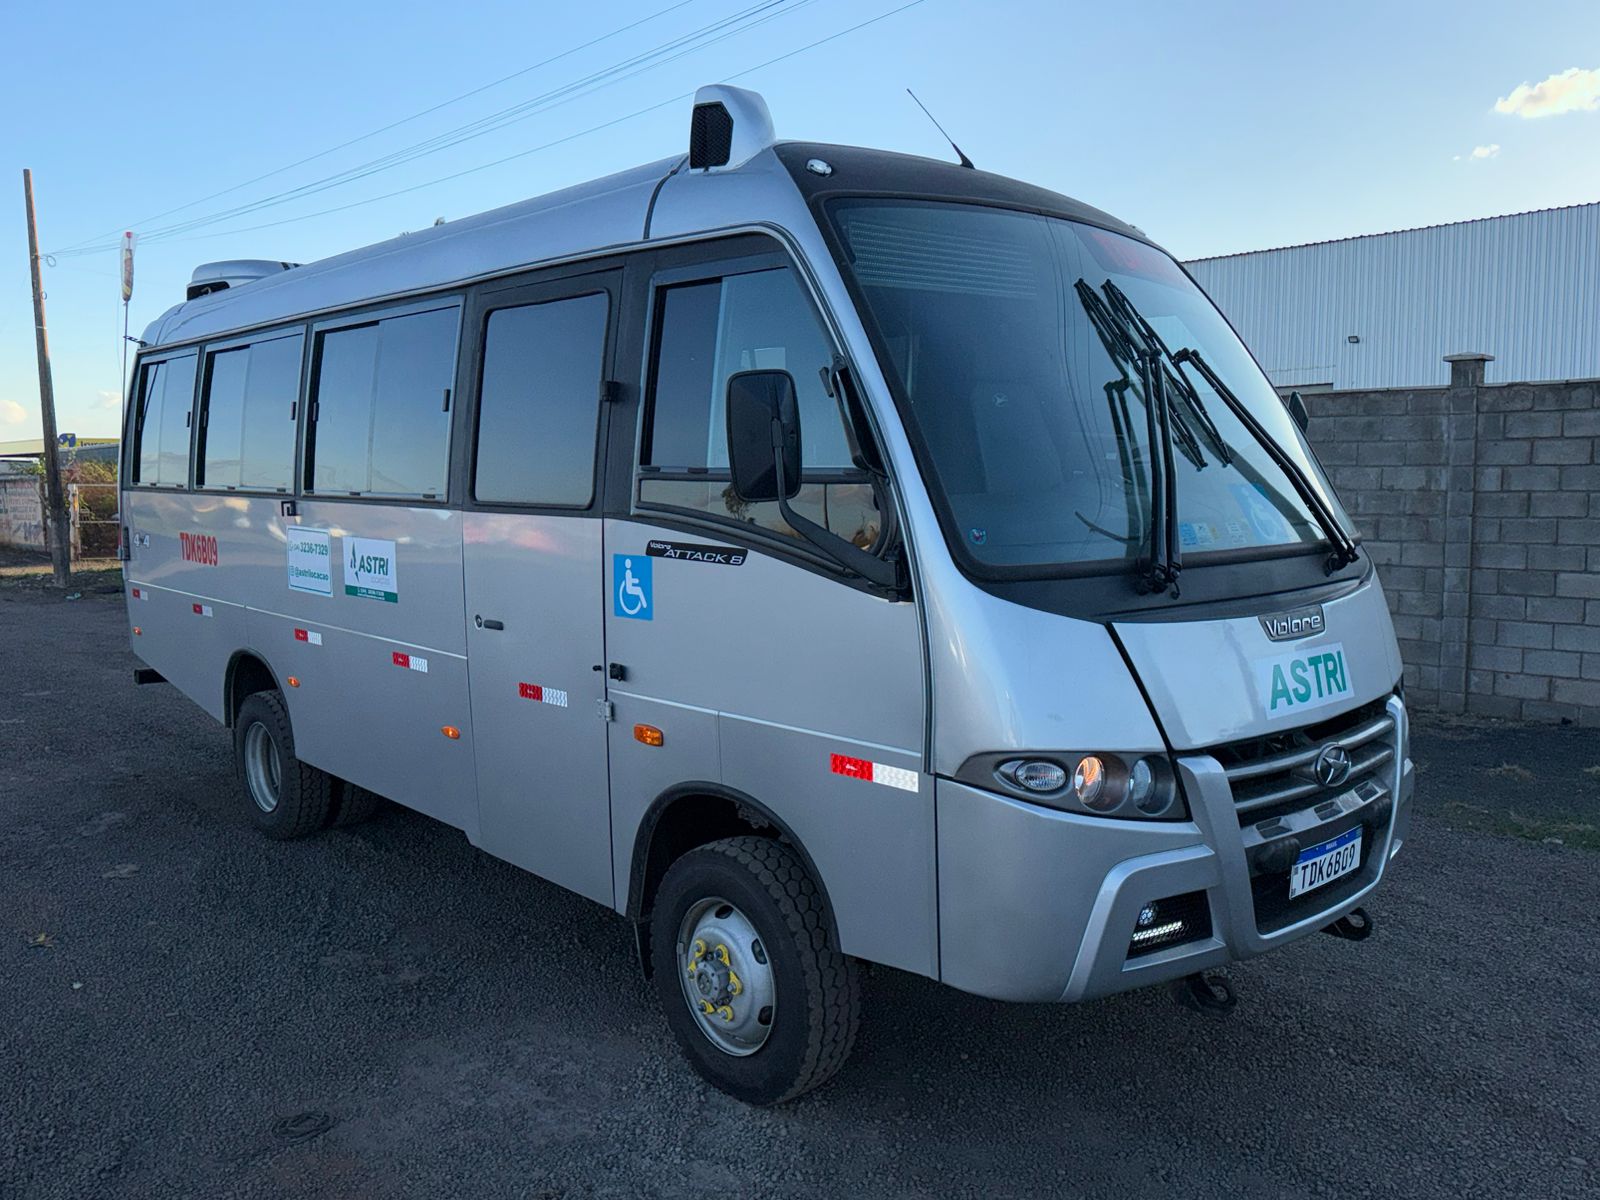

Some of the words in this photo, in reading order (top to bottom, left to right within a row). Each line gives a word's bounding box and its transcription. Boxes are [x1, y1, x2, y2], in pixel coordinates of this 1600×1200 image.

[180, 532, 219, 567] TDK6B09
[664, 549, 728, 563] ATTACK
[730, 555, 744, 565] 8
[359, 554, 389, 576] ASTRI
[1265, 615, 1321, 637] Volare
[1270, 650, 1347, 711] ASTRI
[1301, 843, 1356, 890] TDK6B09
